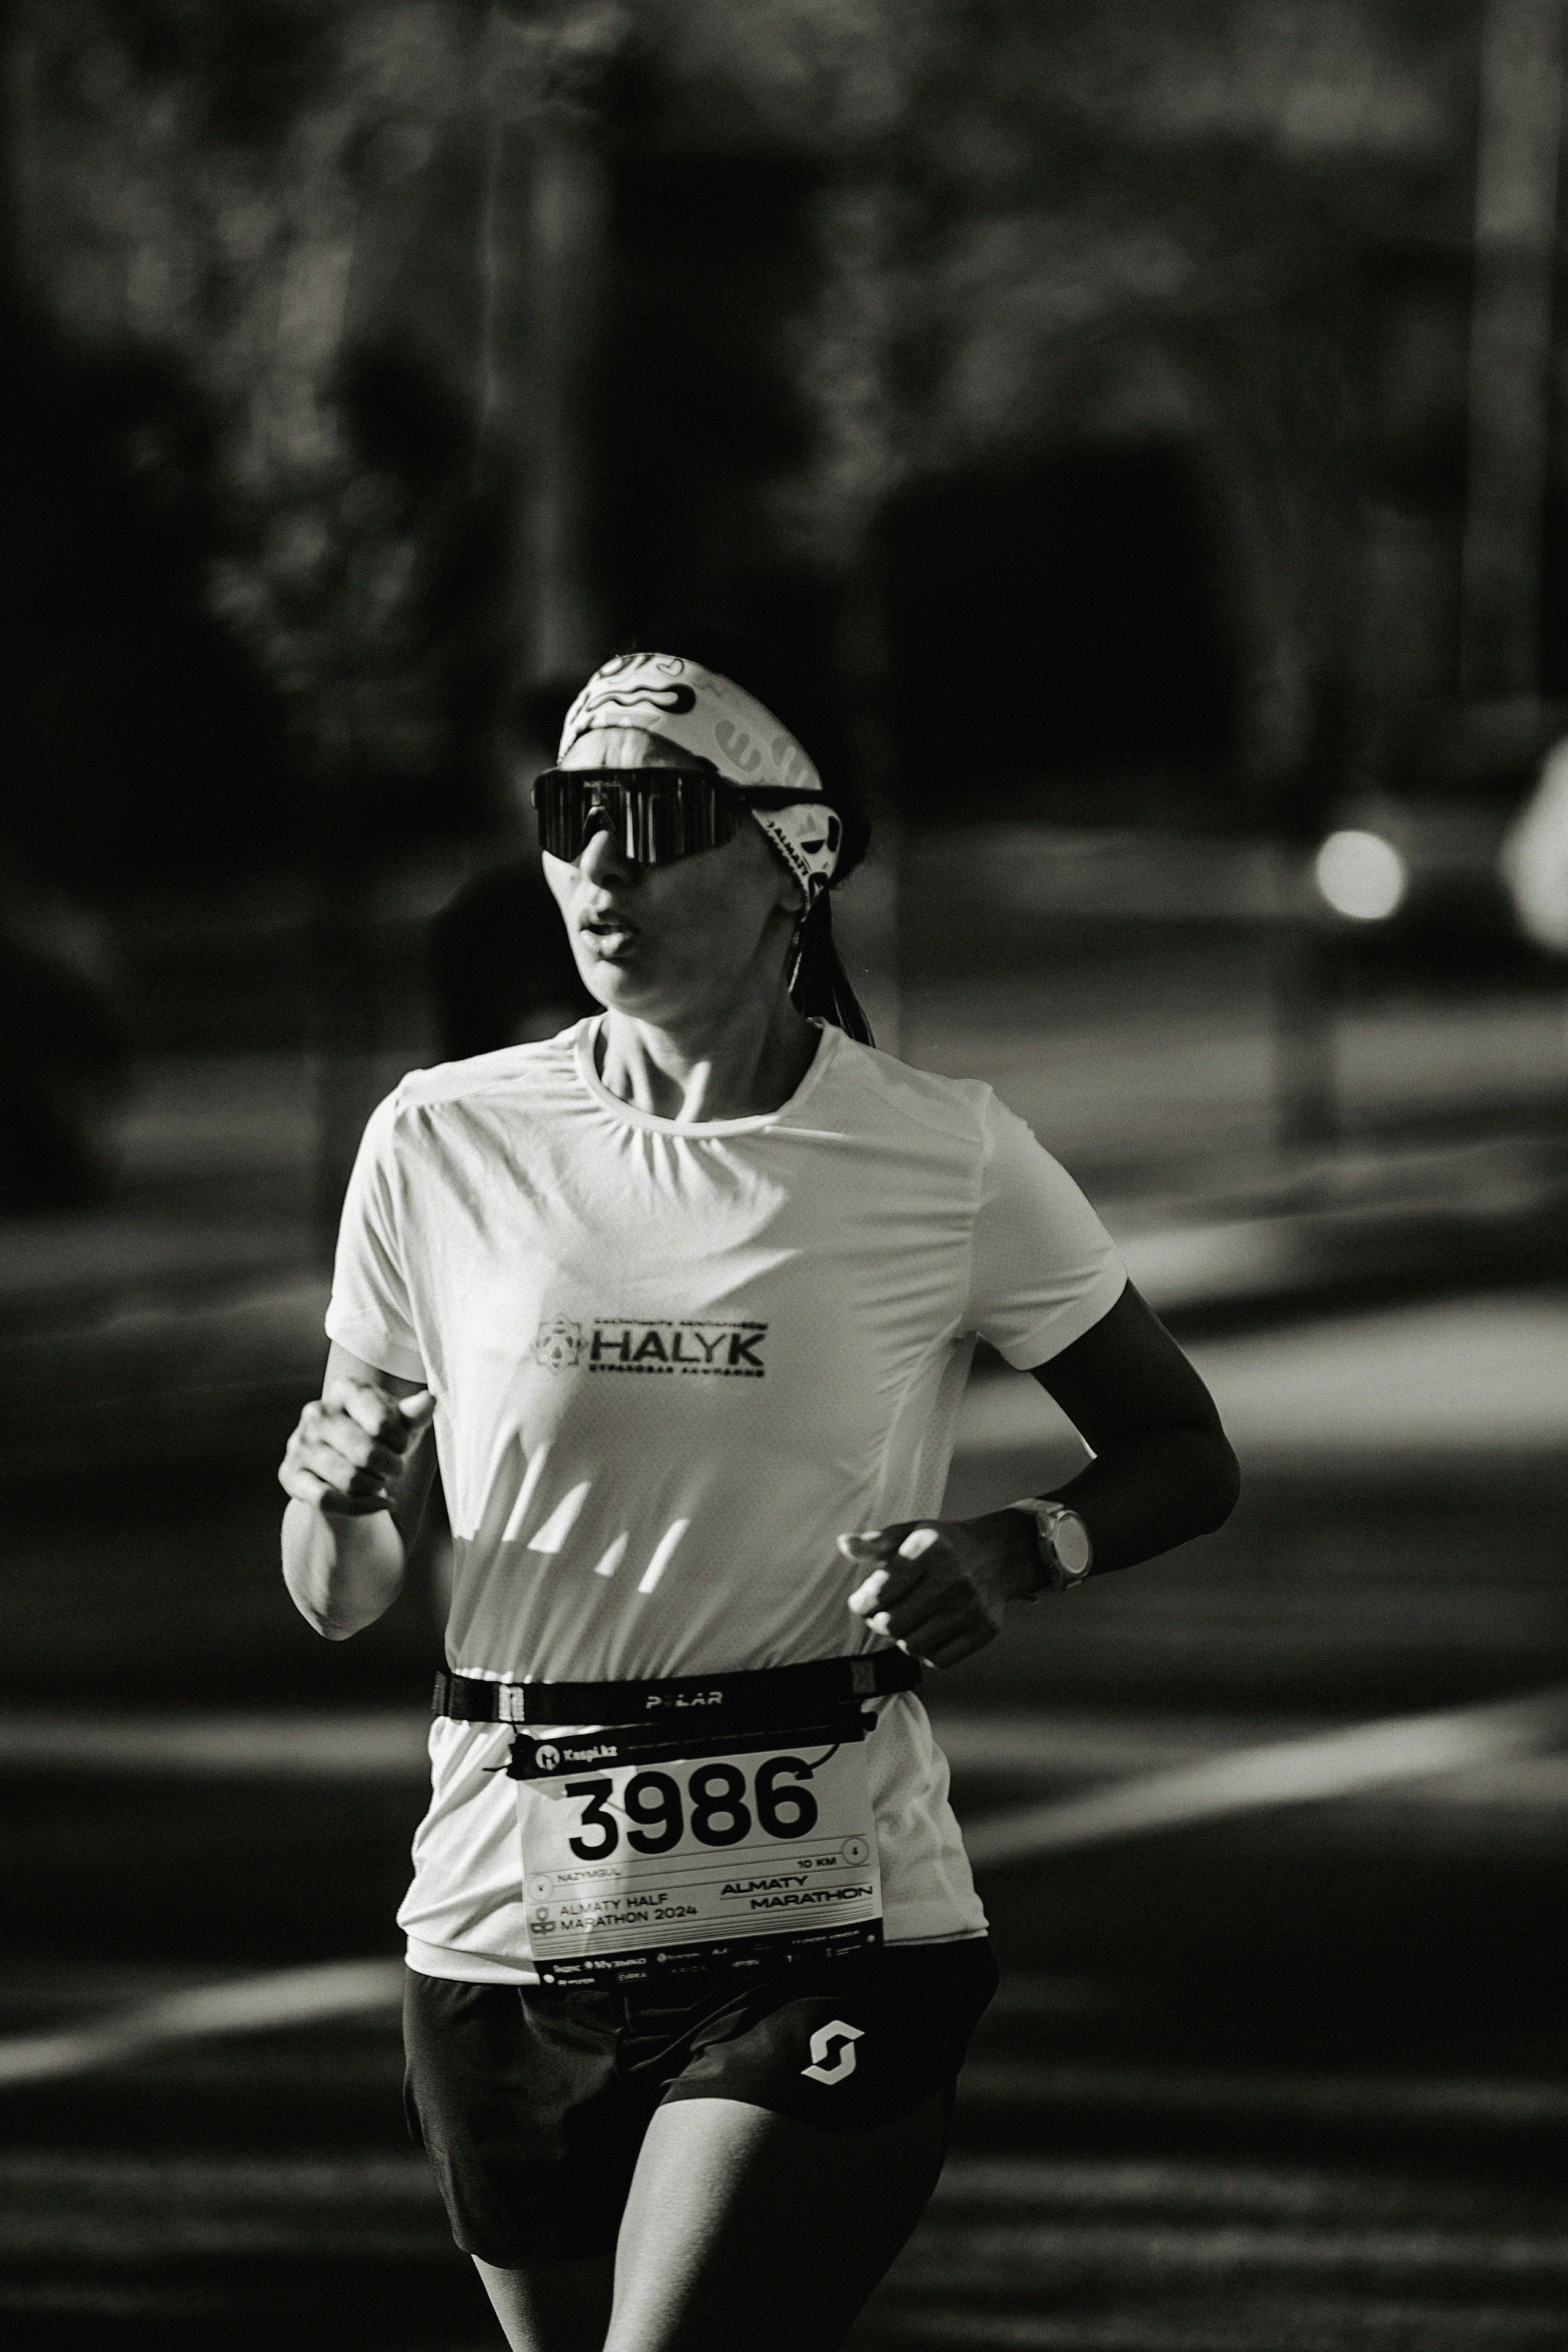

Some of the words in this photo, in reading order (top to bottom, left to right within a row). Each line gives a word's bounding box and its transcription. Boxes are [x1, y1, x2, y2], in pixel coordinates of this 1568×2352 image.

[589, 1330, 766, 1366] HALYK
[564, 1743, 619, 1763] Kaspi.kz
[564, 1755, 818, 1861] 3986
[797, 1860, 813, 1869] 10
[816, 1856, 837, 1867] KM
[558, 1868, 620, 1882] NAZYMGUL
[721, 1875, 809, 1895] ALMATY
[560, 1900, 620, 1917] ALMATY
[627, 1893, 668, 1907] HALF
[750, 1886, 873, 1910] MARATHON
[560, 1910, 649, 1931] MARATHON
[654, 1905, 698, 1920] 2024
